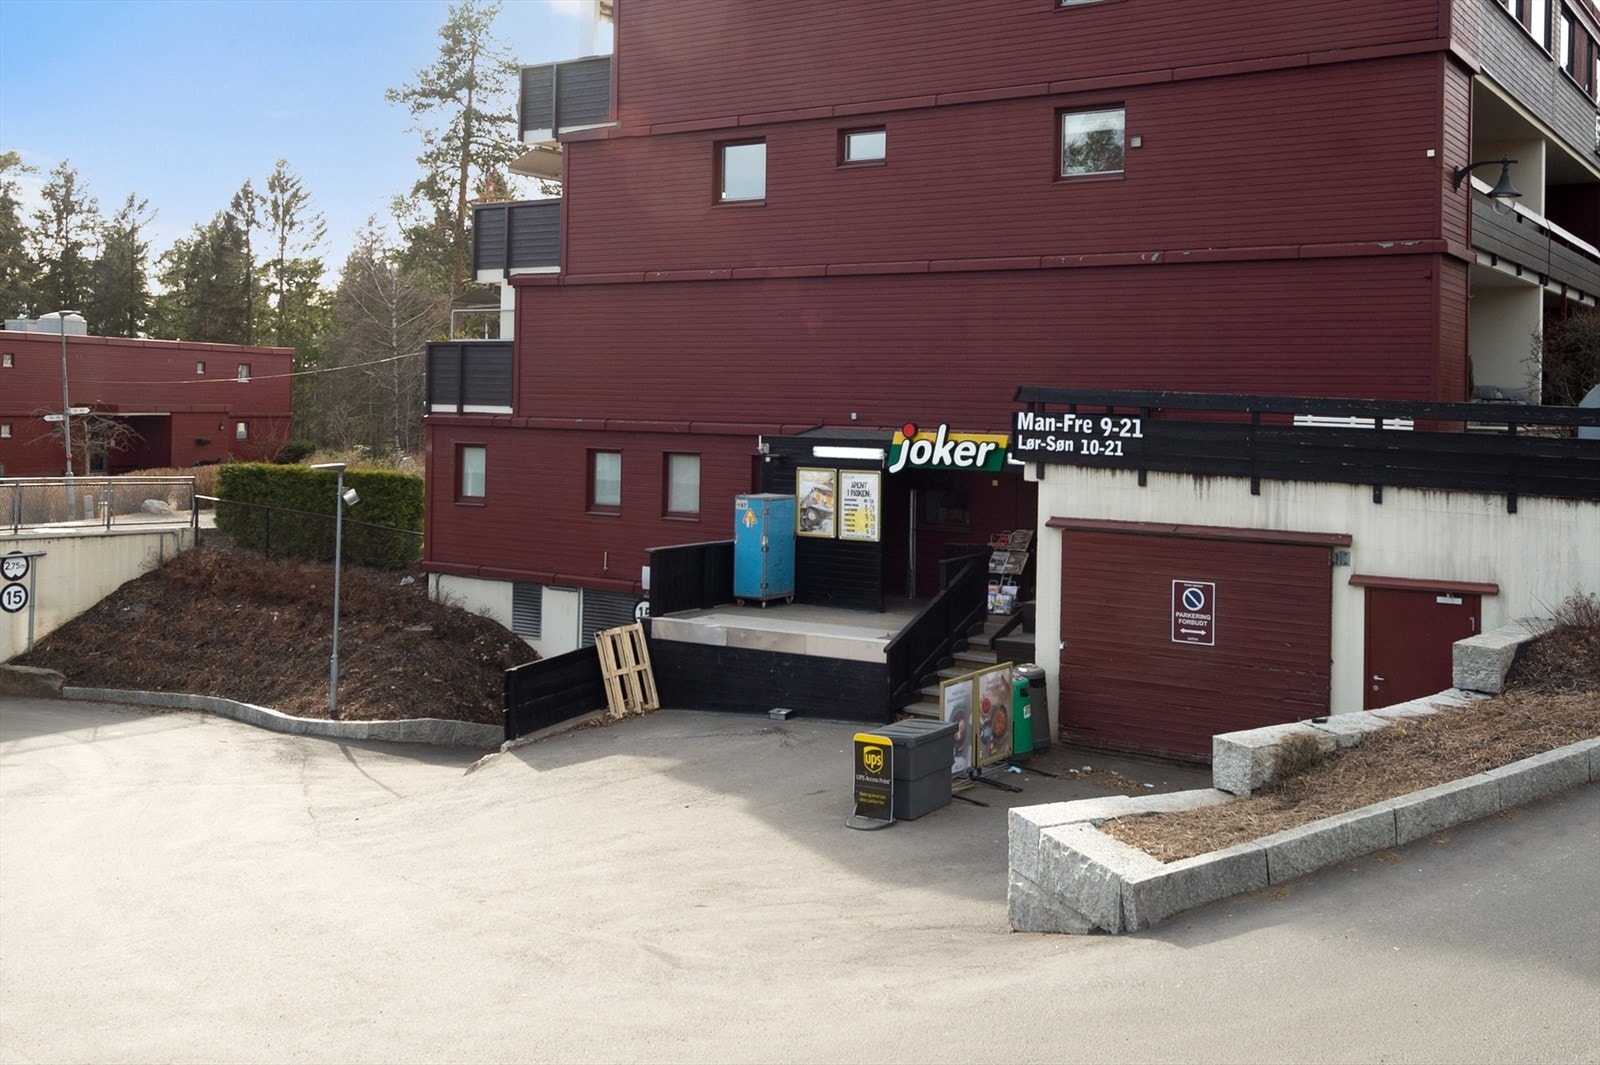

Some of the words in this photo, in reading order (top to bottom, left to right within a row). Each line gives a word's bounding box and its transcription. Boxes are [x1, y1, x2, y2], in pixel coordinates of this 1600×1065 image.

[1017, 412, 1093, 434] Man-Fre
[1100, 417, 1143, 438] 9-21
[889, 424, 996, 474] joker
[1018, 434, 1074, 452] Lør-Søn
[1080, 439, 1124, 456] 10-21
[6, 590, 23, 606] 15
[1175, 611, 1211, 621] PARKERING
[1178, 618, 1208, 627] FORBUDT
